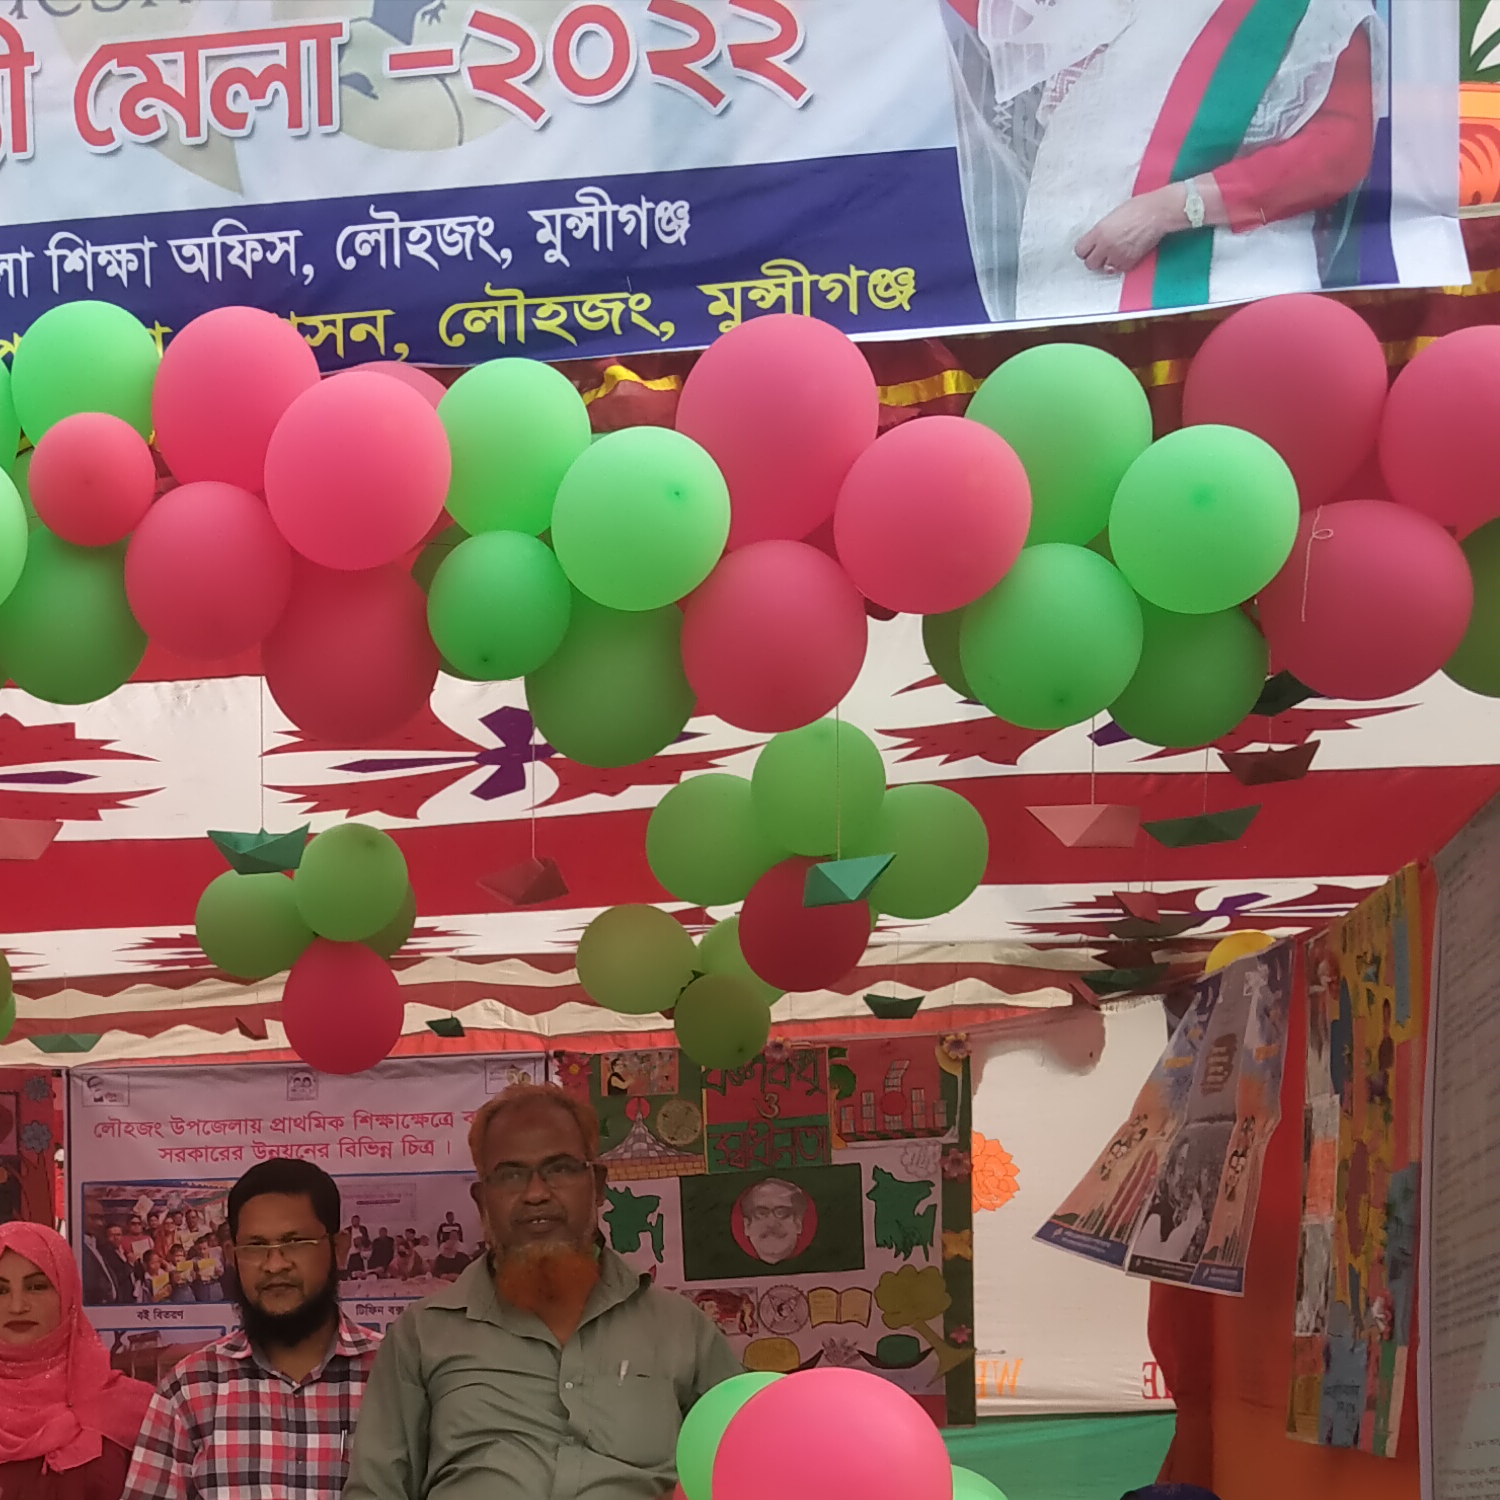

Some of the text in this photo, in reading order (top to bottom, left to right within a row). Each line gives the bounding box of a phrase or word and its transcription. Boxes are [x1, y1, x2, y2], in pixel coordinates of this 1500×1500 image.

[75, 22, 344, 150] মেলা
[46, 231, 156, 293] শিক্ষা
[171, 217, 315, 285] অফিস,
[336, 206, 513, 270] লৌহজং,
[529, 186, 692, 267] মুন্সীগঞ্জ
[437, 283, 674, 347] লৌহজং,
[93, 1118, 162, 1140] লৌহজং
[170, 1114, 262, 1137] উপজেলায়
[270, 1109, 345, 1135] প্রাথমিক
[159, 1145, 244, 1164] সরকারের
[338, 1137, 393, 1160] বিভিন্ন
[401, 1134, 437, 1157] চিত্র
